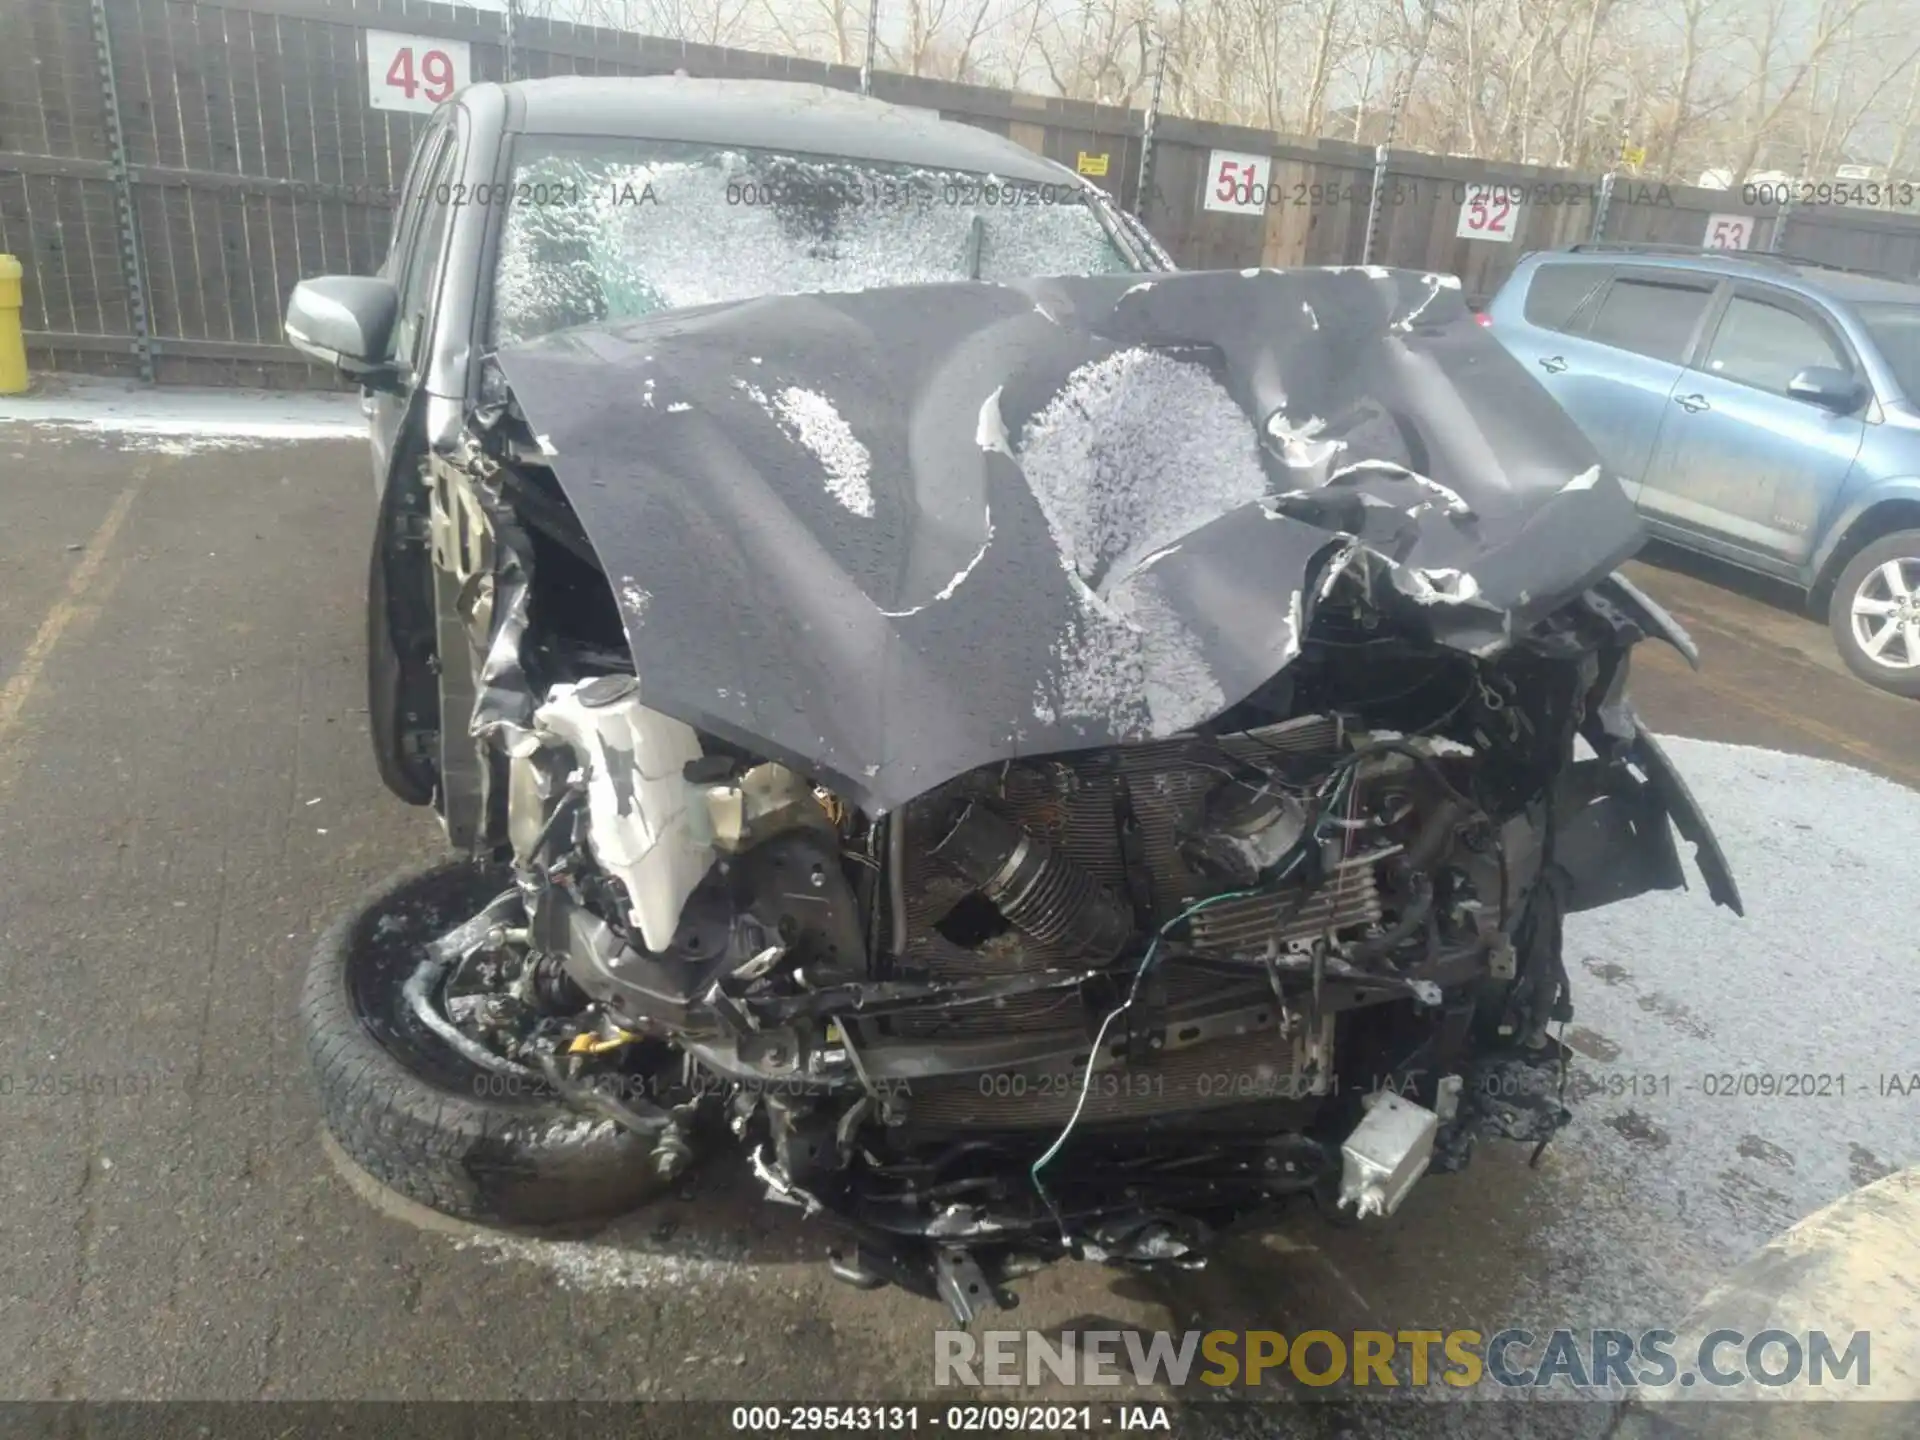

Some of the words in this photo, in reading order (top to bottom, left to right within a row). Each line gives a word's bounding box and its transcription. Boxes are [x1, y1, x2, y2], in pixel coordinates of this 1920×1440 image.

[385, 47, 455, 104] 49
[1215, 160, 1257, 203] 51
[1467, 195, 1512, 232] 52
[1711, 221, 1745, 249] 53
